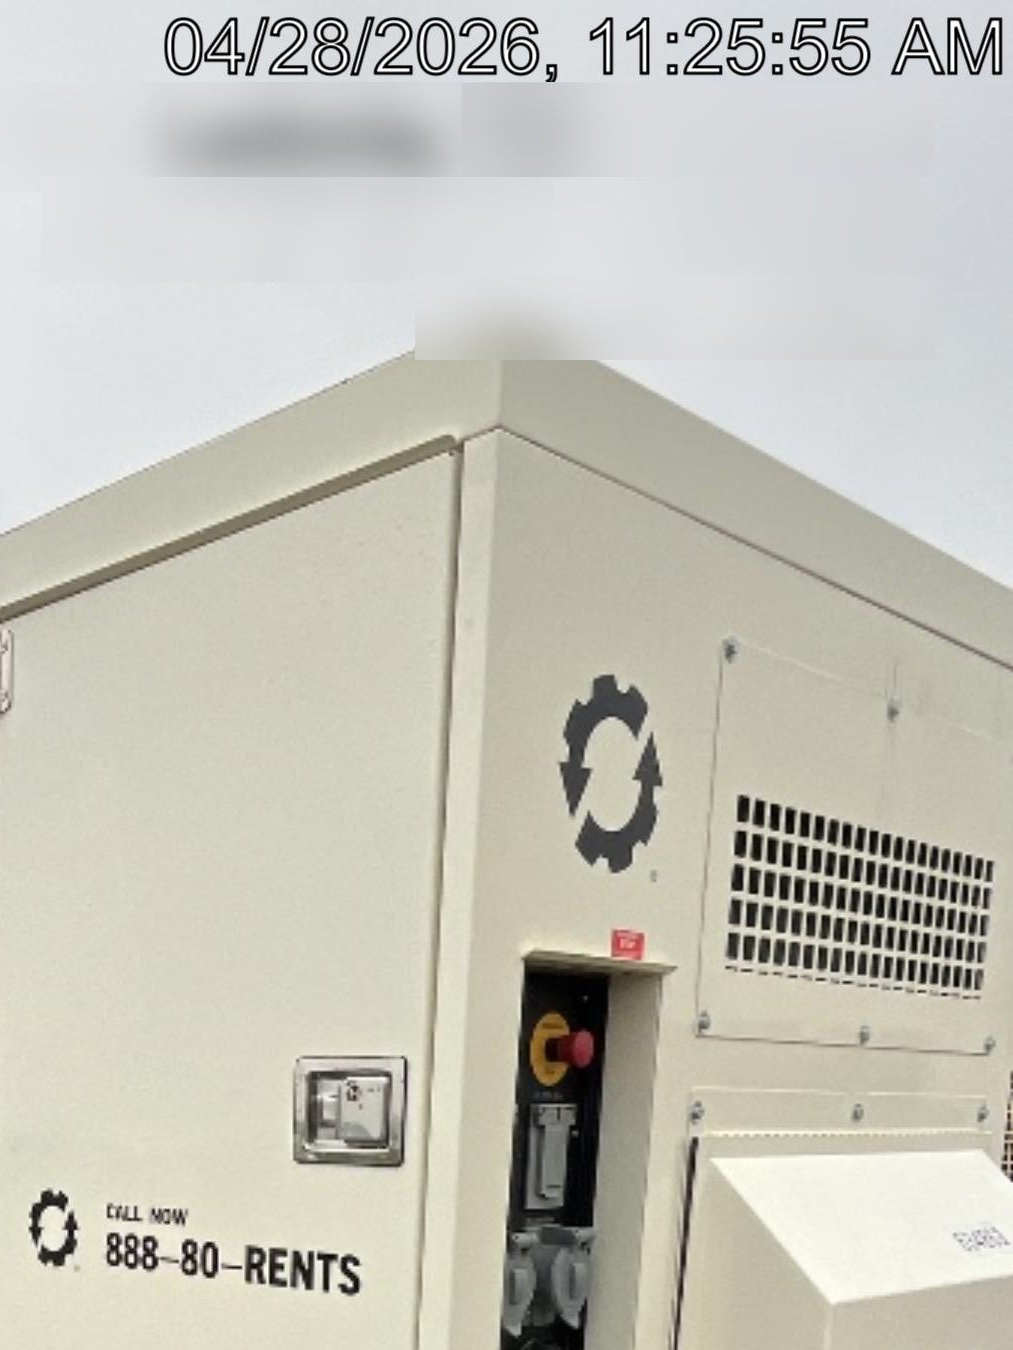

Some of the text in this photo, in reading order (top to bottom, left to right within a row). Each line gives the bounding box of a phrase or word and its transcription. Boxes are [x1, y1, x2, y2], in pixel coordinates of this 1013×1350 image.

[106, 1203, 188, 1226] CALL NOW
[105, 1232, 362, 1296] 888-80-RENTS
